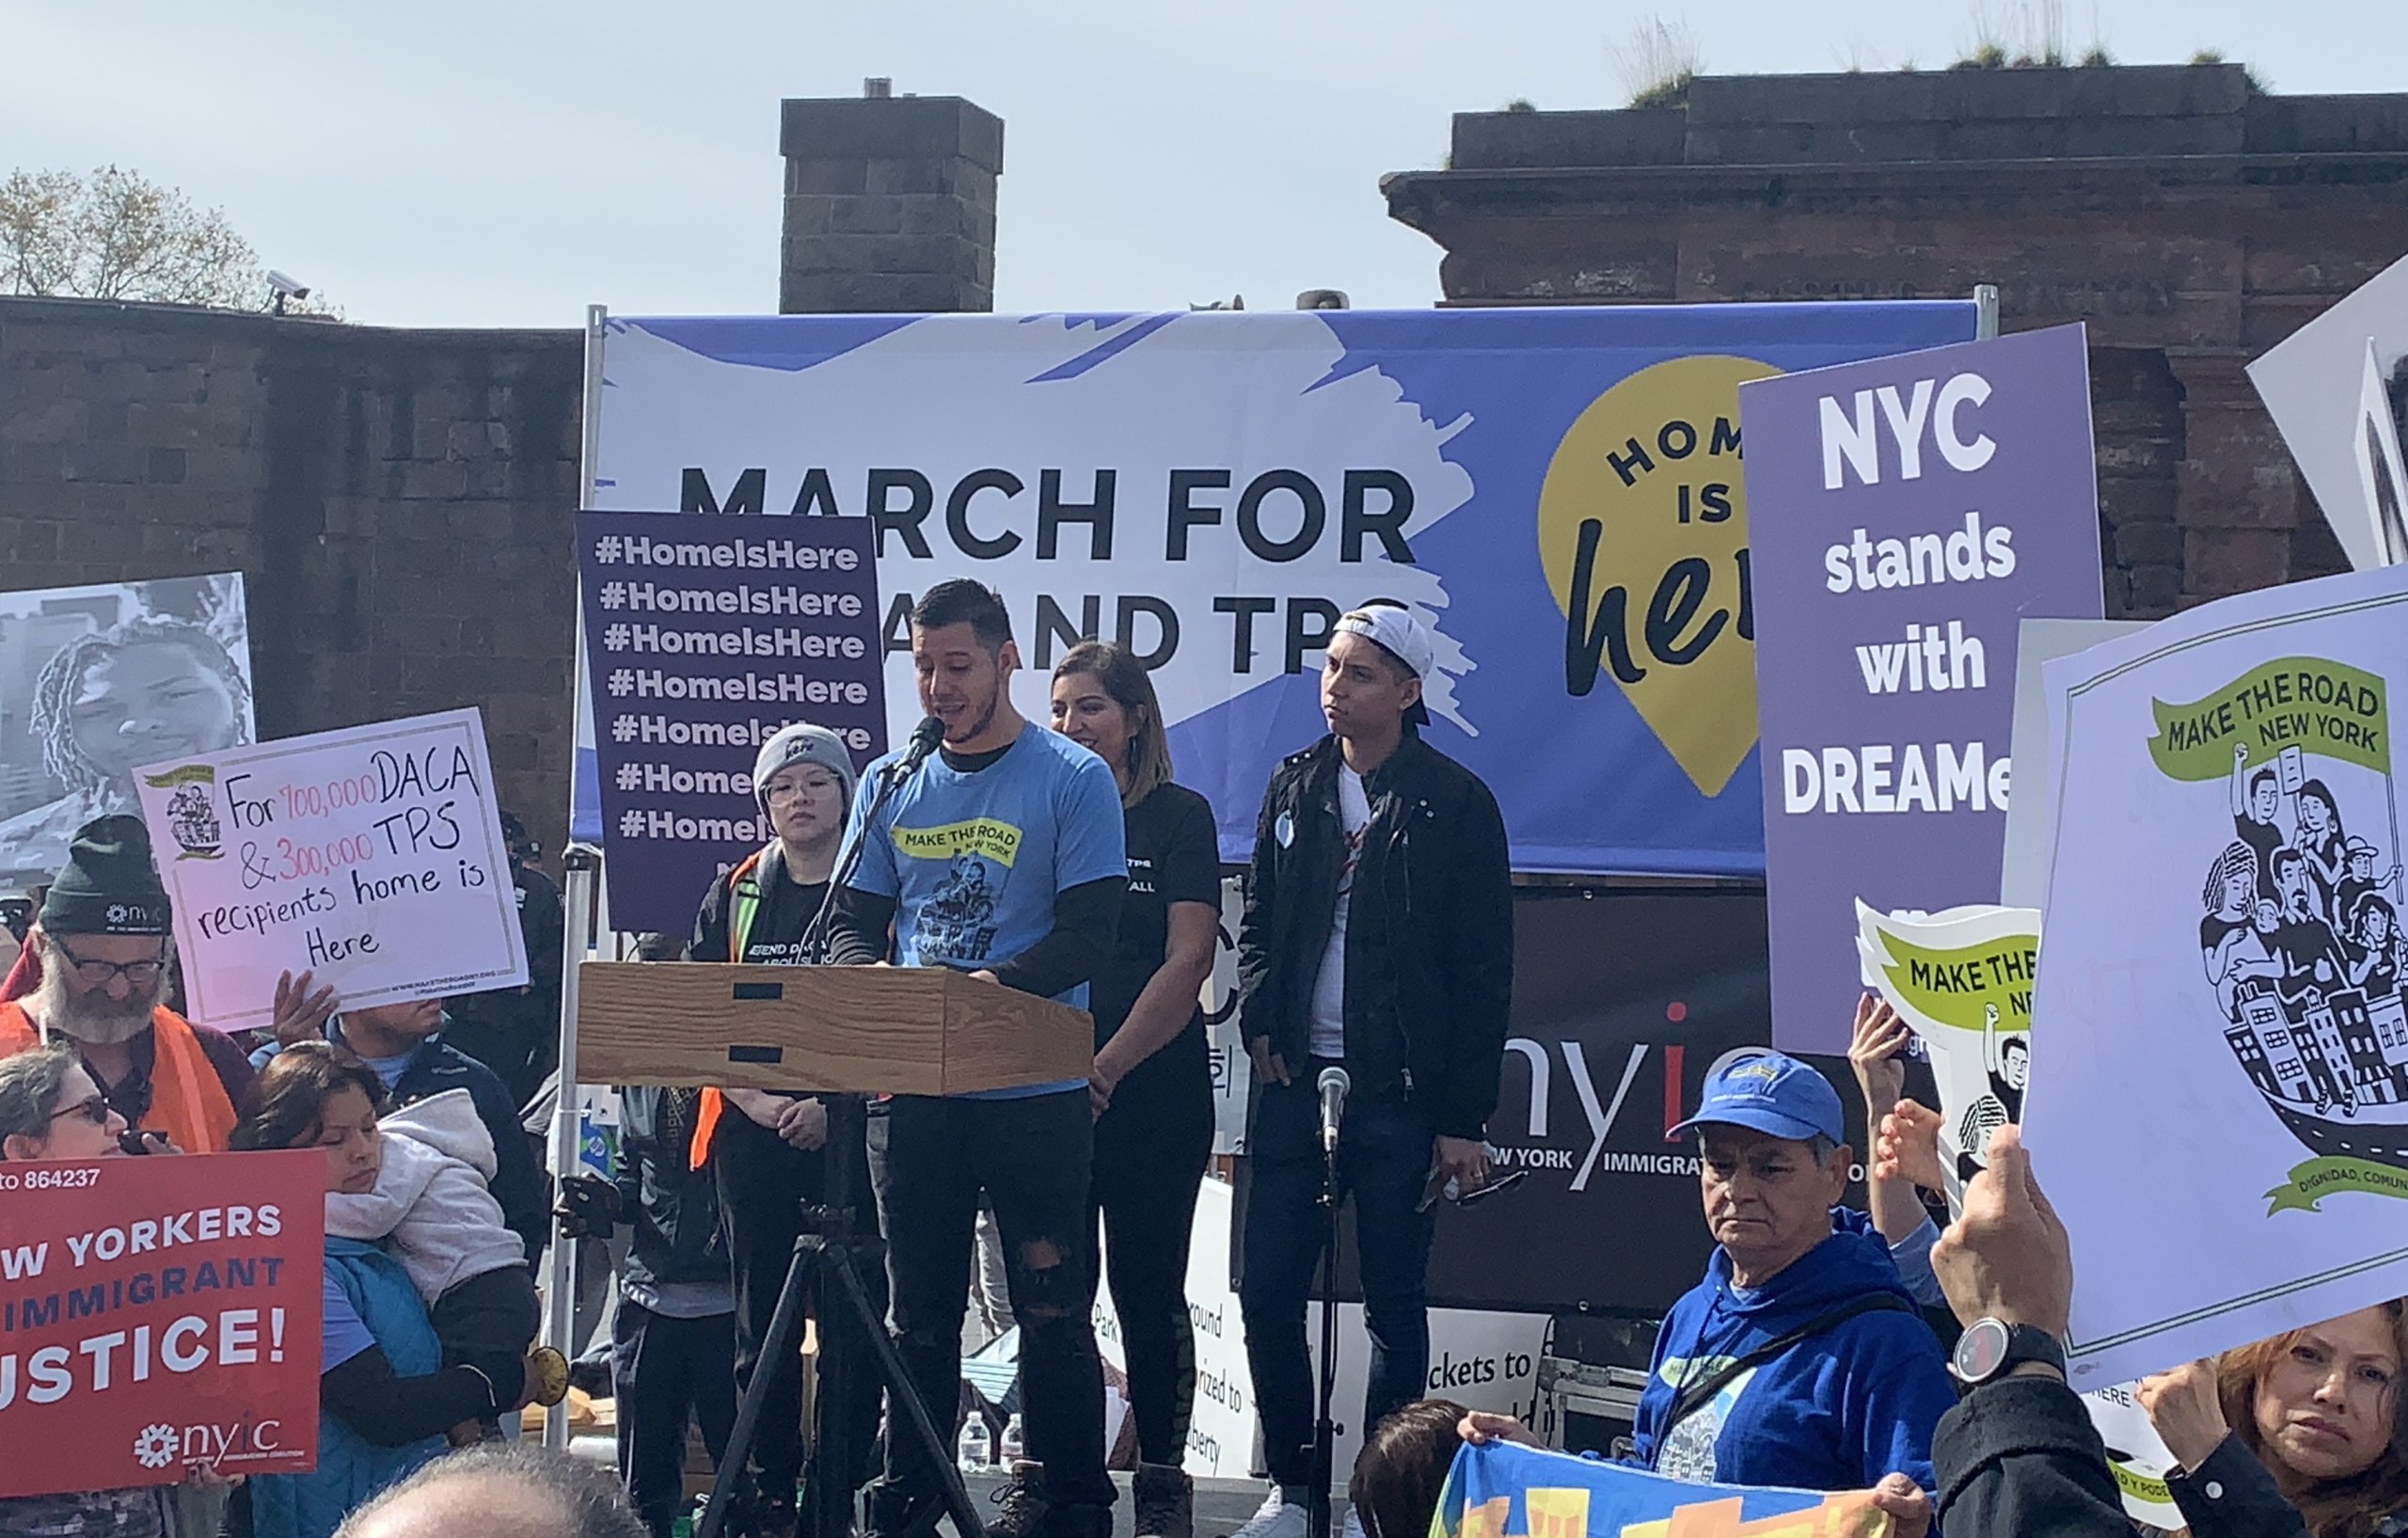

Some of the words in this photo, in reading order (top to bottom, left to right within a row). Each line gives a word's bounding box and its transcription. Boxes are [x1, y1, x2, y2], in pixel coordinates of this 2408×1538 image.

[1819, 373, 1997, 489] NYC
[1607, 416, 1744, 487] HOM
[1165, 469, 1417, 563] FOR
[1678, 484, 1732, 524] IS
[595, 536, 859, 570] #HomeIsHere
[1825, 512, 2016, 594] stands
[600, 581, 863, 616] #HomeIsHere
[604, 624, 865, 658] #HomeIsHere
[1014, 595, 1180, 672] ND
[1213, 597, 1409, 674] TP
[1856, 620, 1986, 693] with
[608, 669, 868, 705] #HomeIsHere
[2168, 702, 2236, 752] MAKE
[2236, 674, 2292, 720] THE
[2298, 673, 2379, 717] ROAD
[2258, 712, 2309, 747] NEW
[2316, 715, 2379, 752] YORK
[226, 774, 276, 829] For
[370, 746, 481, 802] DACA
[1782, 741, 2010, 815] DREAMe
[240, 841, 276, 889] &
[277, 833, 373, 880] 300,000
[372, 801, 460, 854] TPS
[905, 832, 946, 846] MAKE
[977, 825, 1016, 846] ROAD
[986, 840, 1011, 859] YORK
[198, 886, 337, 941] recipients
[351, 869, 440, 904] home
[458, 859, 484, 887] is
[1129, 881, 1155, 892] ALL
[306, 927, 380, 966] Here
[1910, 958, 1987, 993] MAKE
[24, 1168, 101, 1188] 864237
[1516, 1149, 1573, 1169] YORK
[1604, 1153, 1703, 1176] IMMIGRA
[2364, 1171, 2408, 1190] COMUN
[67, 1204, 281, 1267] YORKERS
[5, 1257, 285, 1332] IMMIGRANT
[0, 1308, 285, 1411] USTICE!
[1428, 1351, 1495, 1390] ckets
[1505, 1352, 1531, 1380] to
[1198, 1357, 1227, 1404] rized
[1228, 1380, 1243, 1413] to
[2141, 1482, 2169, 1498] PODE
